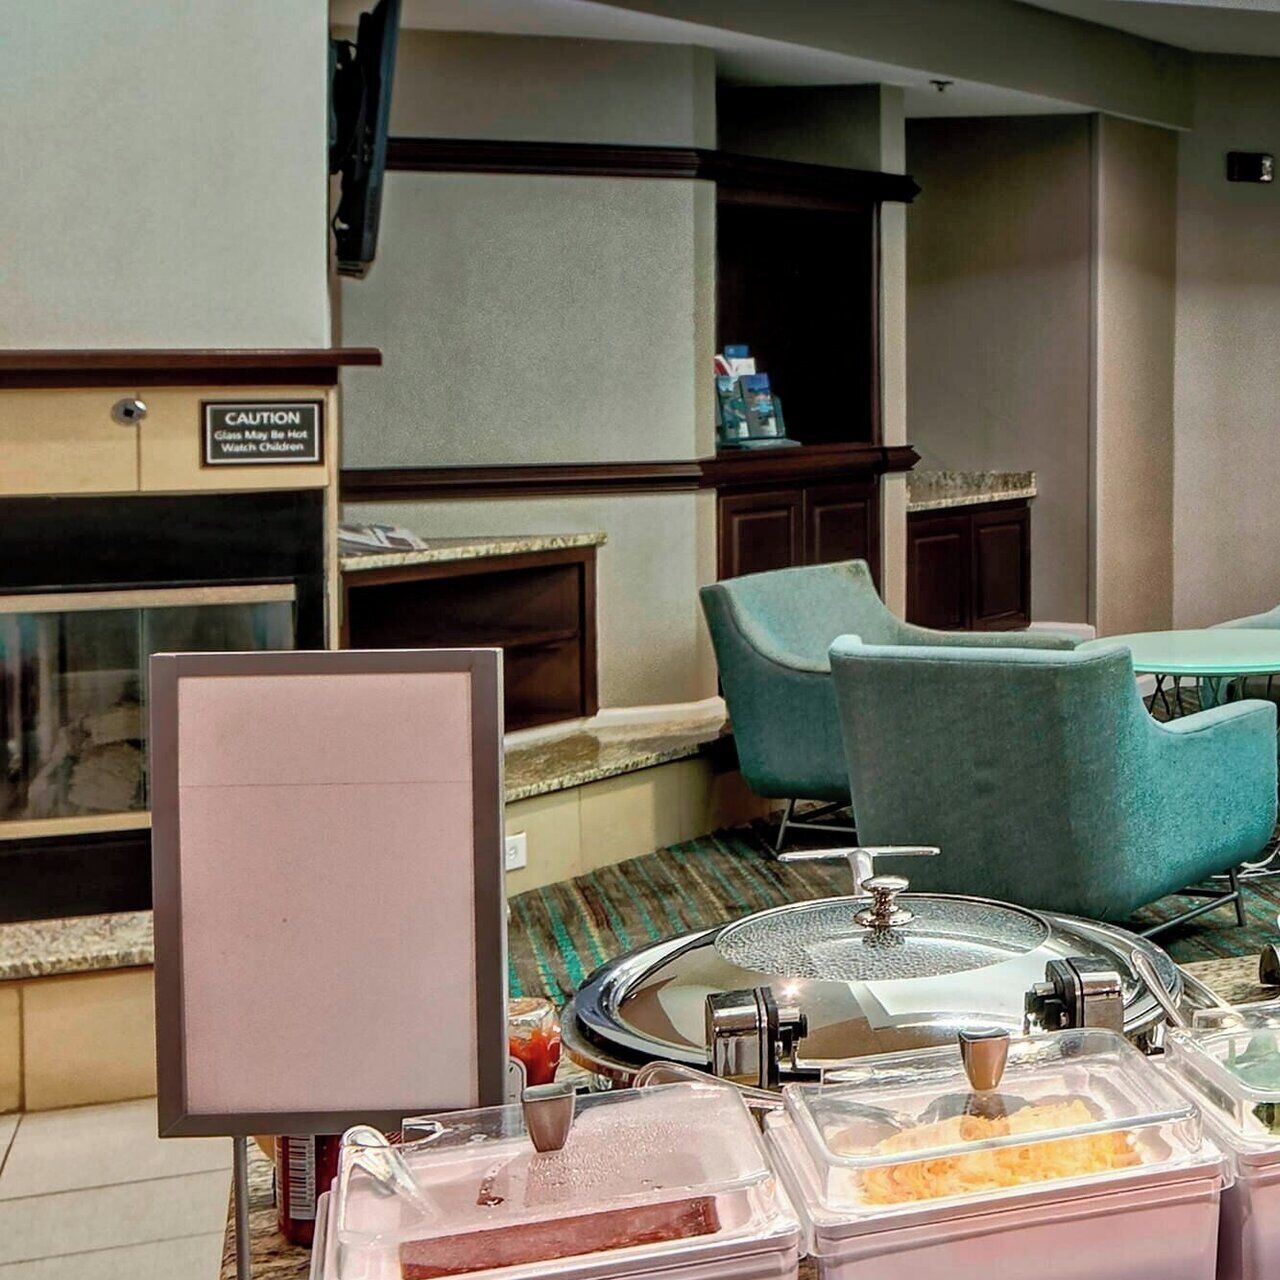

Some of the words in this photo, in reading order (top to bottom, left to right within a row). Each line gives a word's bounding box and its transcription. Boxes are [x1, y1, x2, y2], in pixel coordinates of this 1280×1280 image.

[225, 411, 300, 425] CAUTION
[214, 430, 242, 440] Glass
[245, 430, 268, 441] May
[270, 430, 285, 439] Be
[287, 430, 308, 439] Hot
[221, 443, 256, 452] Watch
[259, 442, 304, 452] Children
